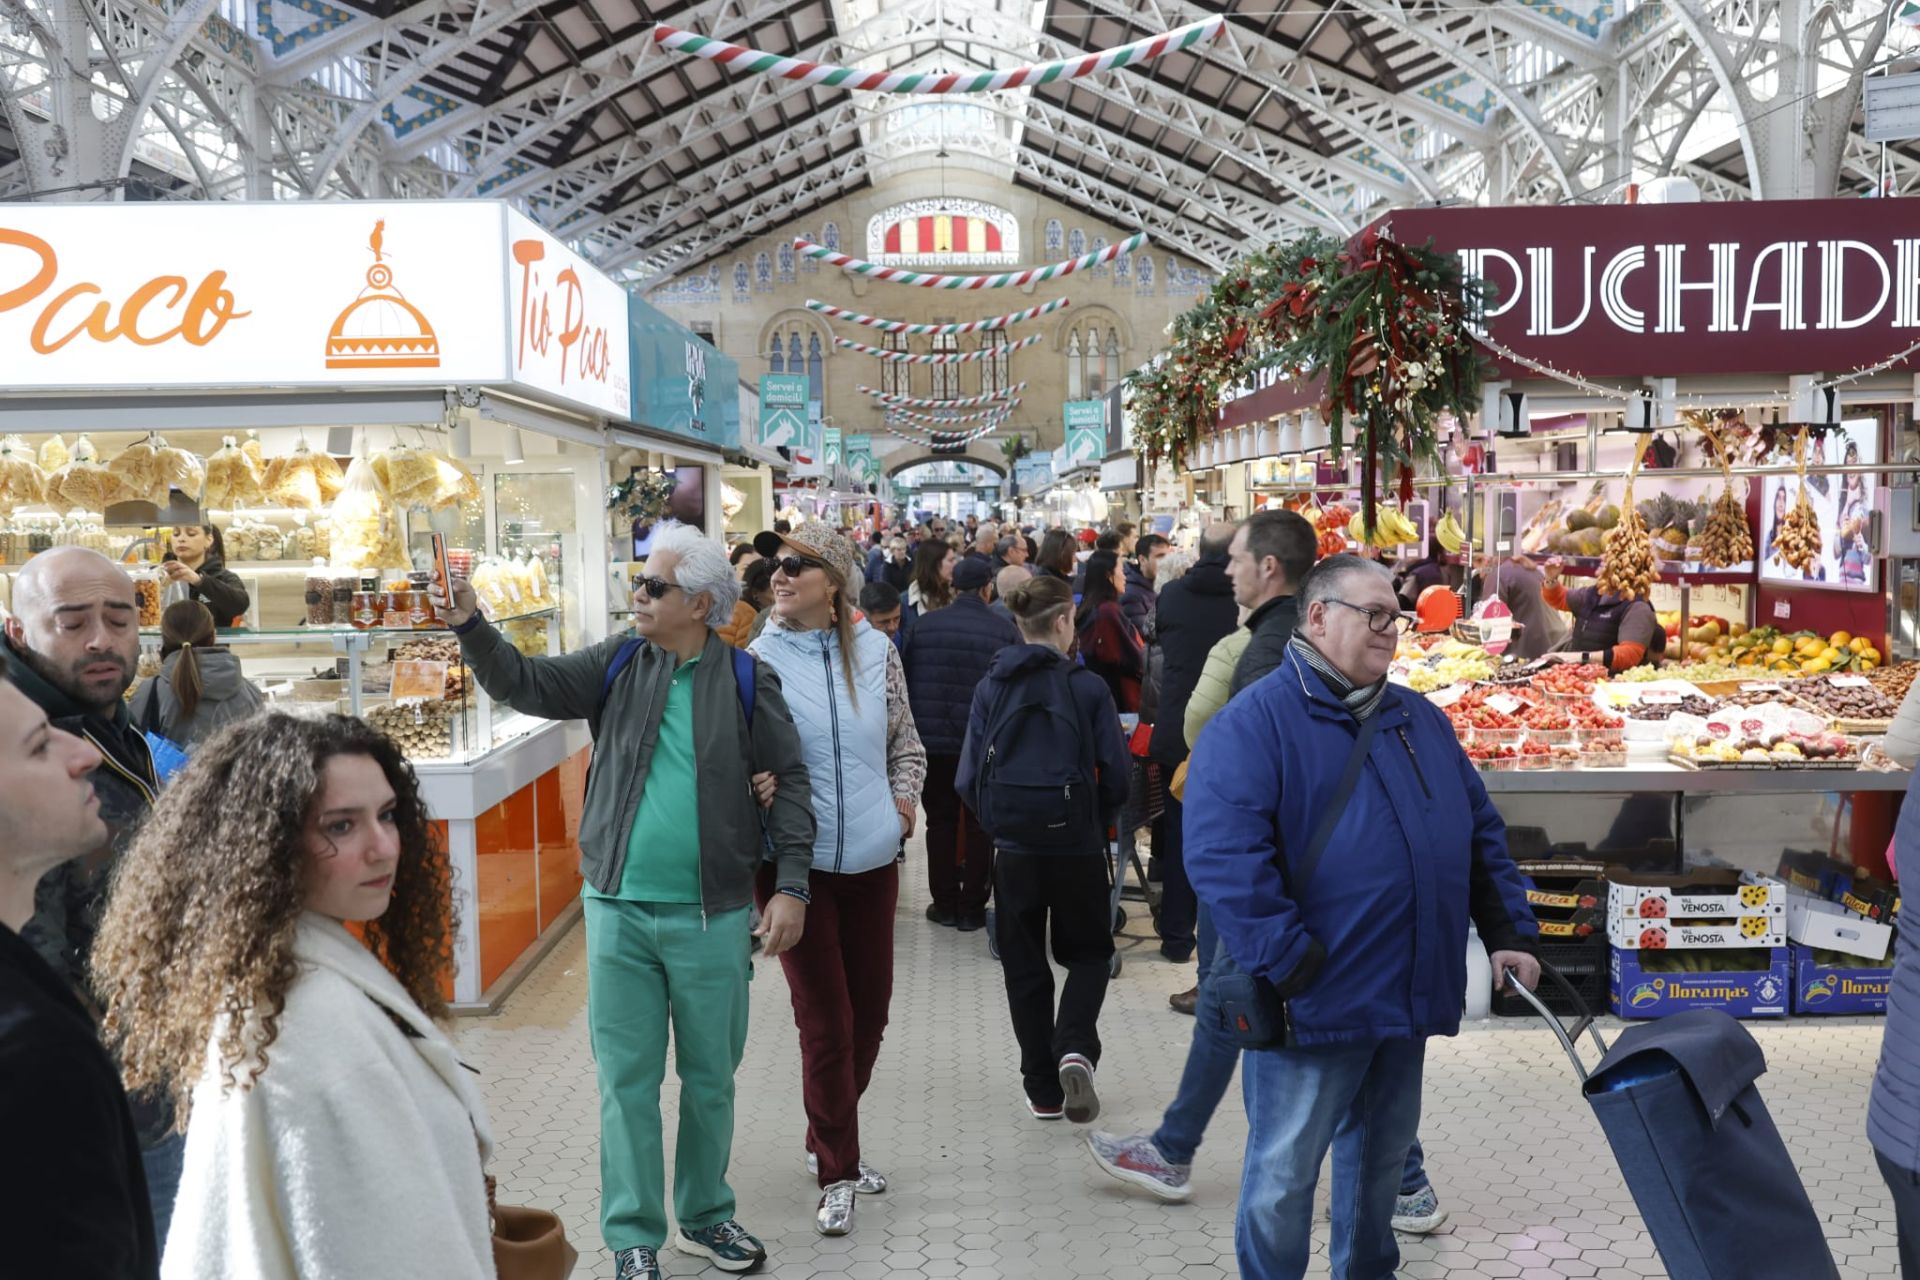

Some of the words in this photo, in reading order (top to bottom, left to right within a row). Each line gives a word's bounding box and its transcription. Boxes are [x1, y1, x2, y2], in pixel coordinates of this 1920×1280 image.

[512, 239, 553, 371] Tio
[557, 264, 610, 386] Paco
[766, 380, 795, 392] Servei
[766, 392, 803, 402] domicili
[1680, 903, 1725, 913] VENOSTA
[1680, 934, 1725, 944] VENOSTA
[1669, 983, 1749, 1001] Doramas
[1841, 979, 1889, 995] Dora
